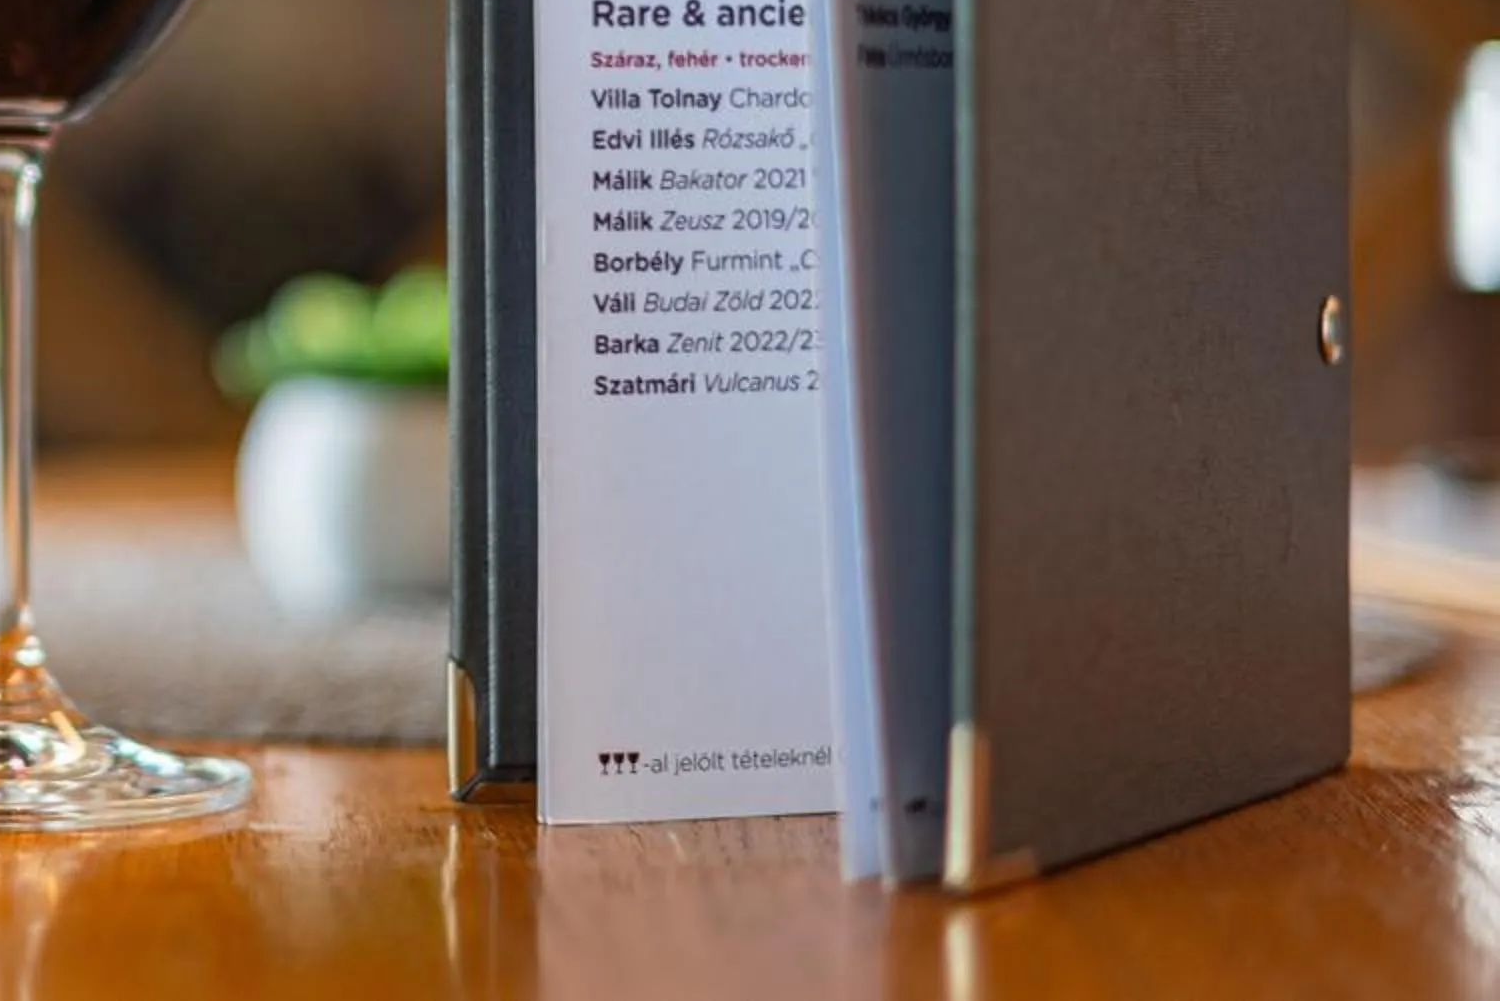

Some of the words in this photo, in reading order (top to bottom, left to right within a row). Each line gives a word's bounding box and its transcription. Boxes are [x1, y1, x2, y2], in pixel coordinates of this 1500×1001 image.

[592, 0, 671, 27] Rare
[682, 0, 706, 27] &
[717, 0, 806, 27] ancie
[591, 50, 661, 70] Száraz,
[669, 50, 717, 68] fehér
[592, 89, 640, 108] Villa
[649, 89, 721, 114] Tolnay
[729, 89, 811, 109] Chardo
[592, 130, 642, 149] Edvi
[650, 130, 694, 148] Illés
[703, 128, 794, 148] Rózsakő
[593, 170, 652, 190] Málik
[660, 170, 747, 190] Bakator
[754, 169, 806, 189] 2021
[594, 211, 652, 231] Málik
[660, 211, 724, 230] Zeusz
[594, 252, 683, 276] Borbély
[692, 251, 782, 272] Furmint
[790, 250, 818, 272] „C
[594, 294, 635, 313] Váli
[644, 292, 707, 312] Budai
[714, 289, 763, 311] Zöld
[770, 290, 818, 310] 202
[596, 334, 659, 354] Barka
[667, 333, 724, 353] Zenit
[595, 376, 695, 396] Szatmári
[704, 373, 799, 393] Vulcanus
[807, 371, 818, 390] 2
[674, 751, 723, 776] jelölt
[732, 747, 831, 770] tételeknél
